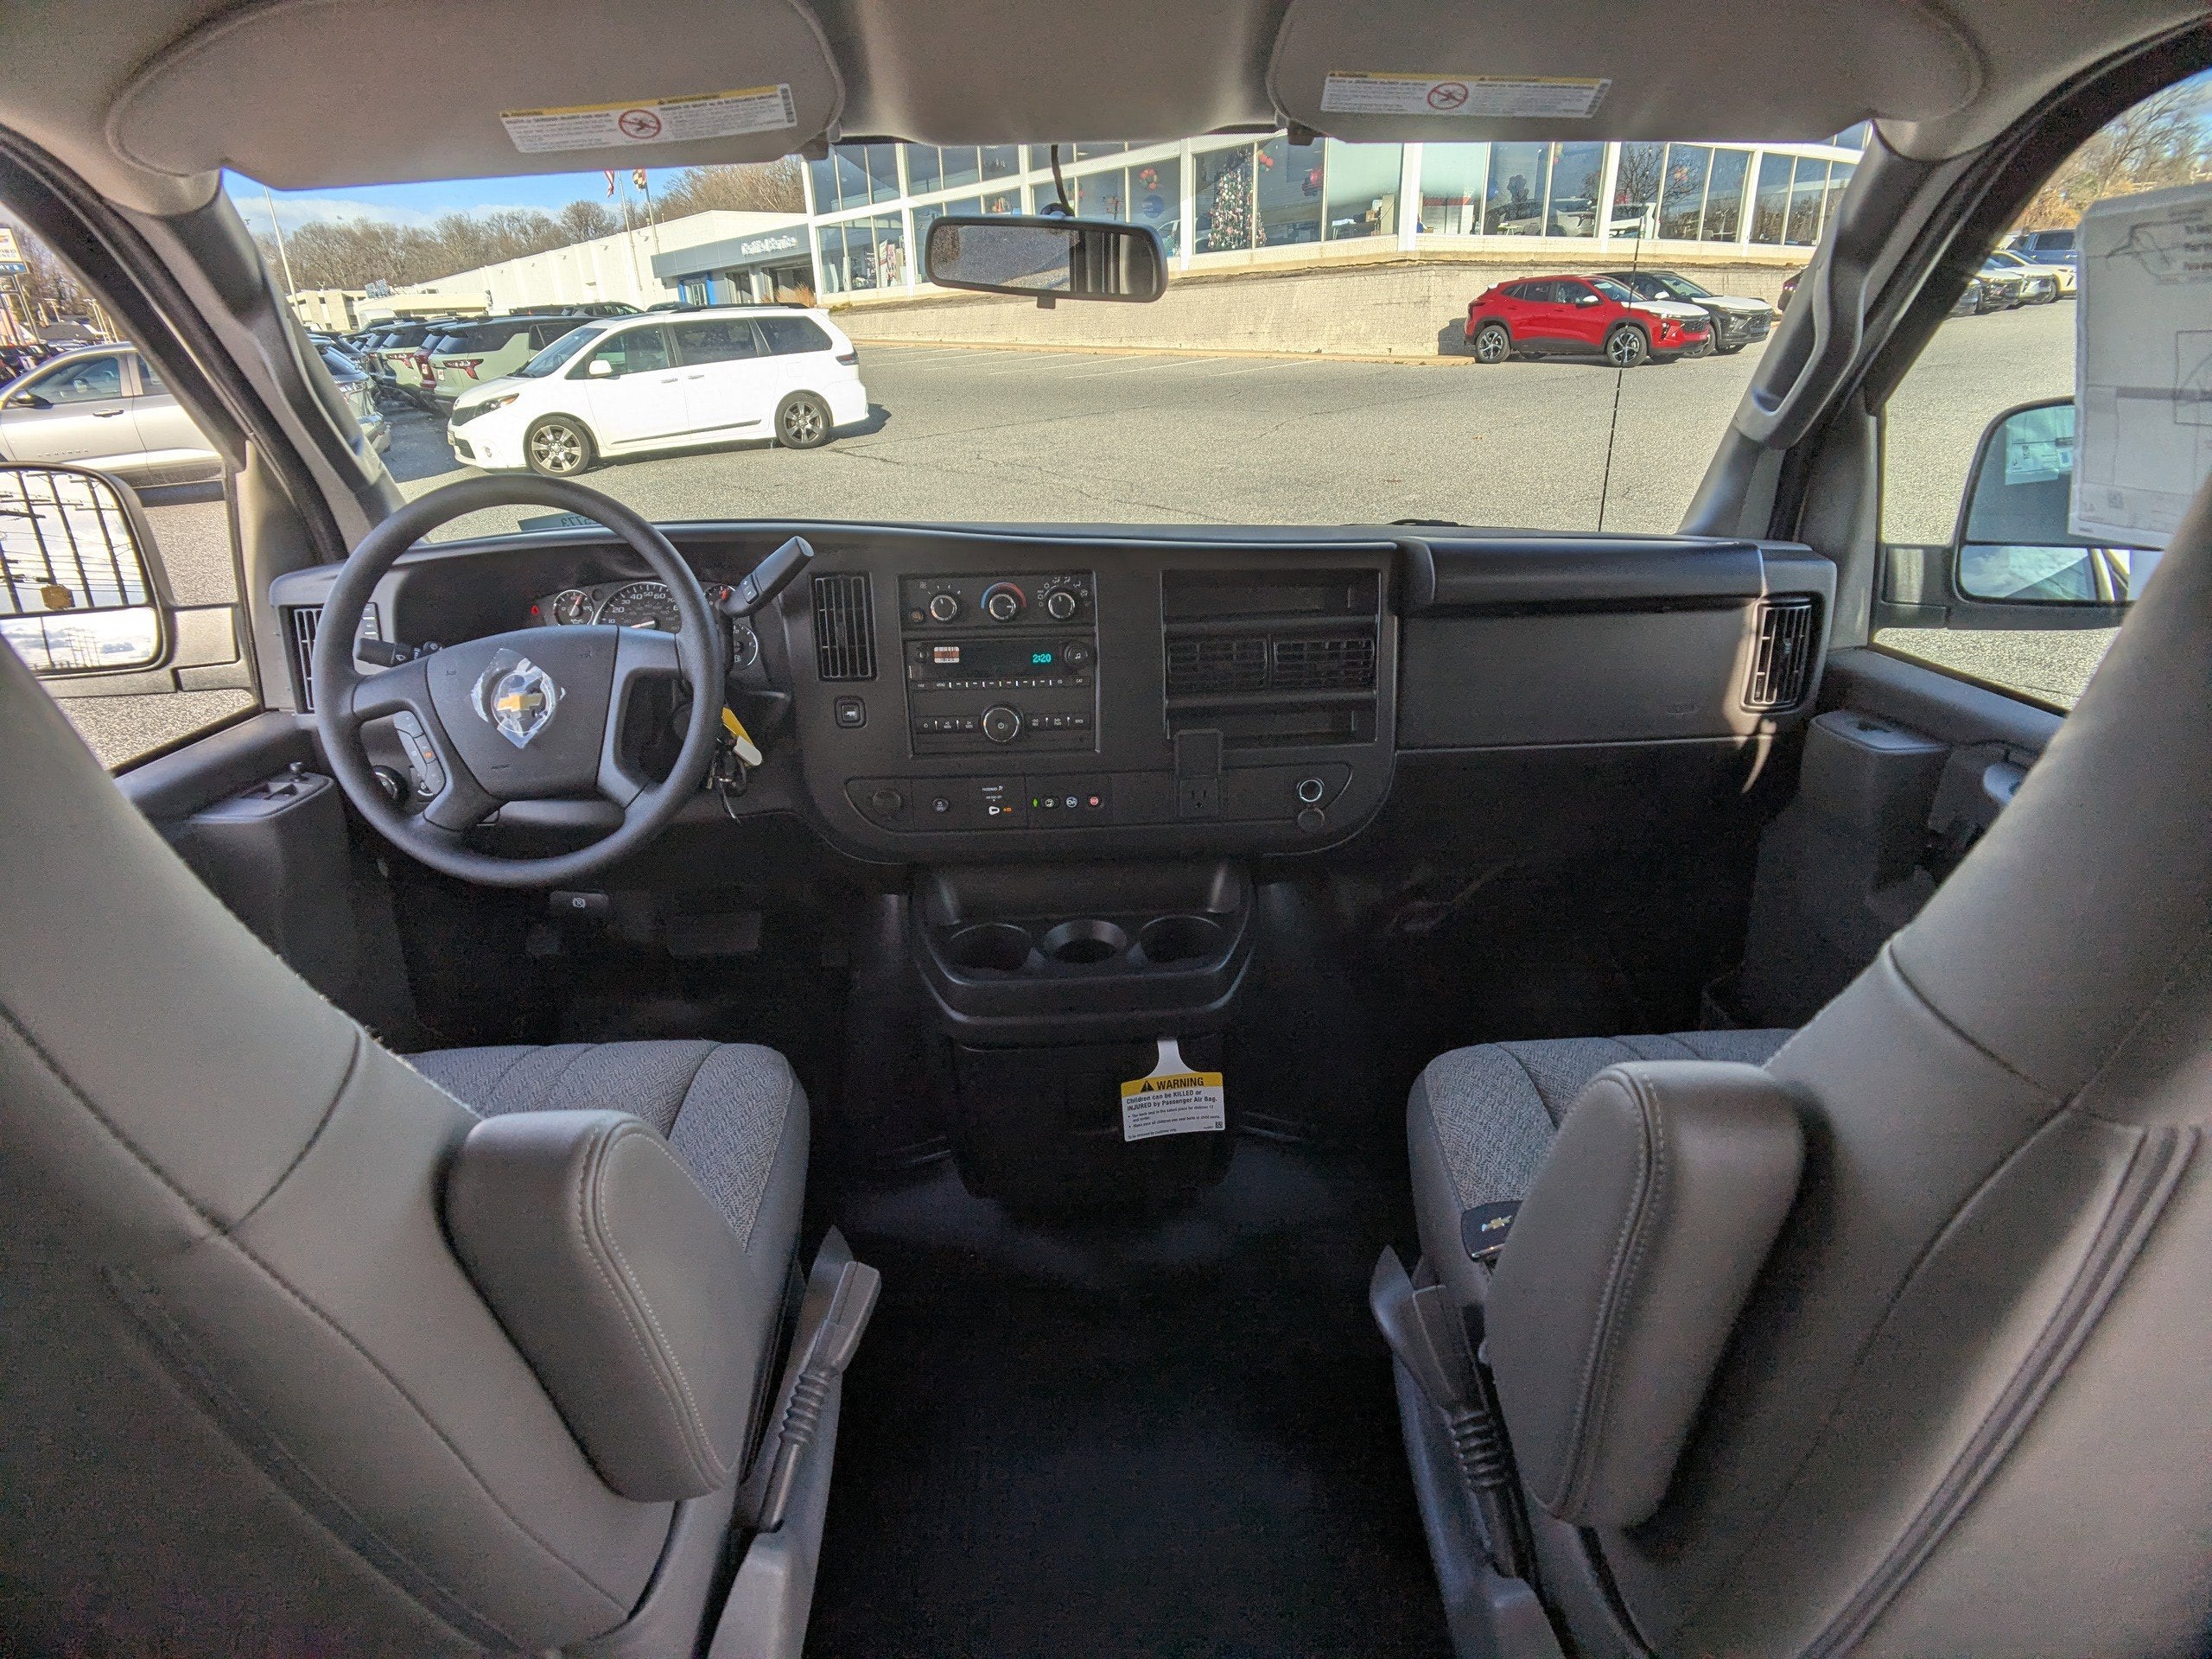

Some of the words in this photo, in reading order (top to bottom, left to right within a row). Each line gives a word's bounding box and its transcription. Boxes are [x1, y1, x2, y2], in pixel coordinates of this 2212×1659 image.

[1033, 653, 1052, 664] 2:20
[1157, 1077, 1205, 1090] WARNING
[1126, 1096, 1151, 1105] Children
[1127, 1103, 1152, 1112] INJURED
[1161, 1098, 1192, 1107] Passenger
